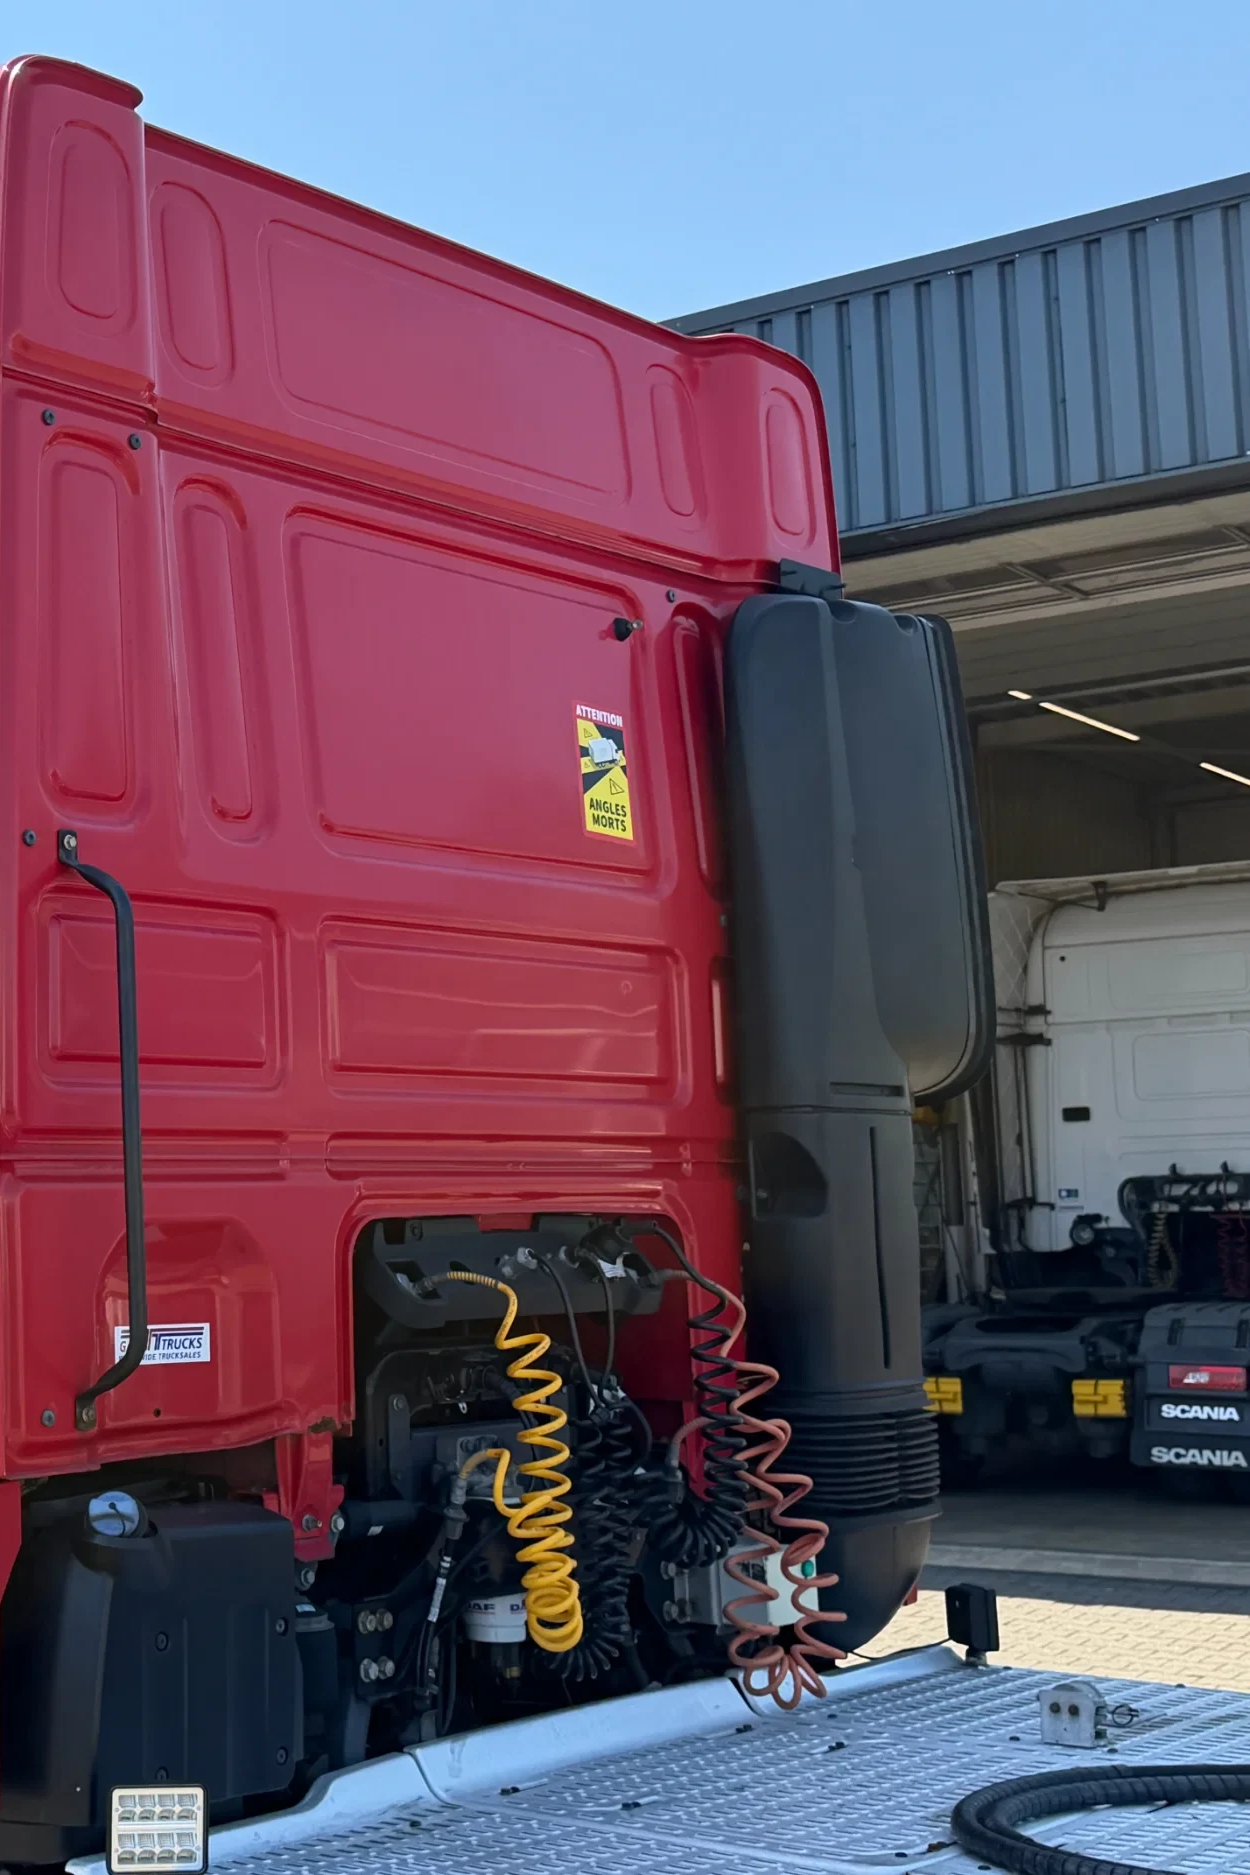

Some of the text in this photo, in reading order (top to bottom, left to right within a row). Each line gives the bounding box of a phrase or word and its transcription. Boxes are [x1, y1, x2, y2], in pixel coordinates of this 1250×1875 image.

[576, 704, 623, 727] ATTENTION
[589, 797, 627, 817] ANGLES
[592, 813, 627, 832] MORTS
[158, 1351, 201, 1361] TRUCKSALES
[1161, 1403, 1240, 1421] SCANIA
[1150, 1446, 1248, 1468] SCANIA
